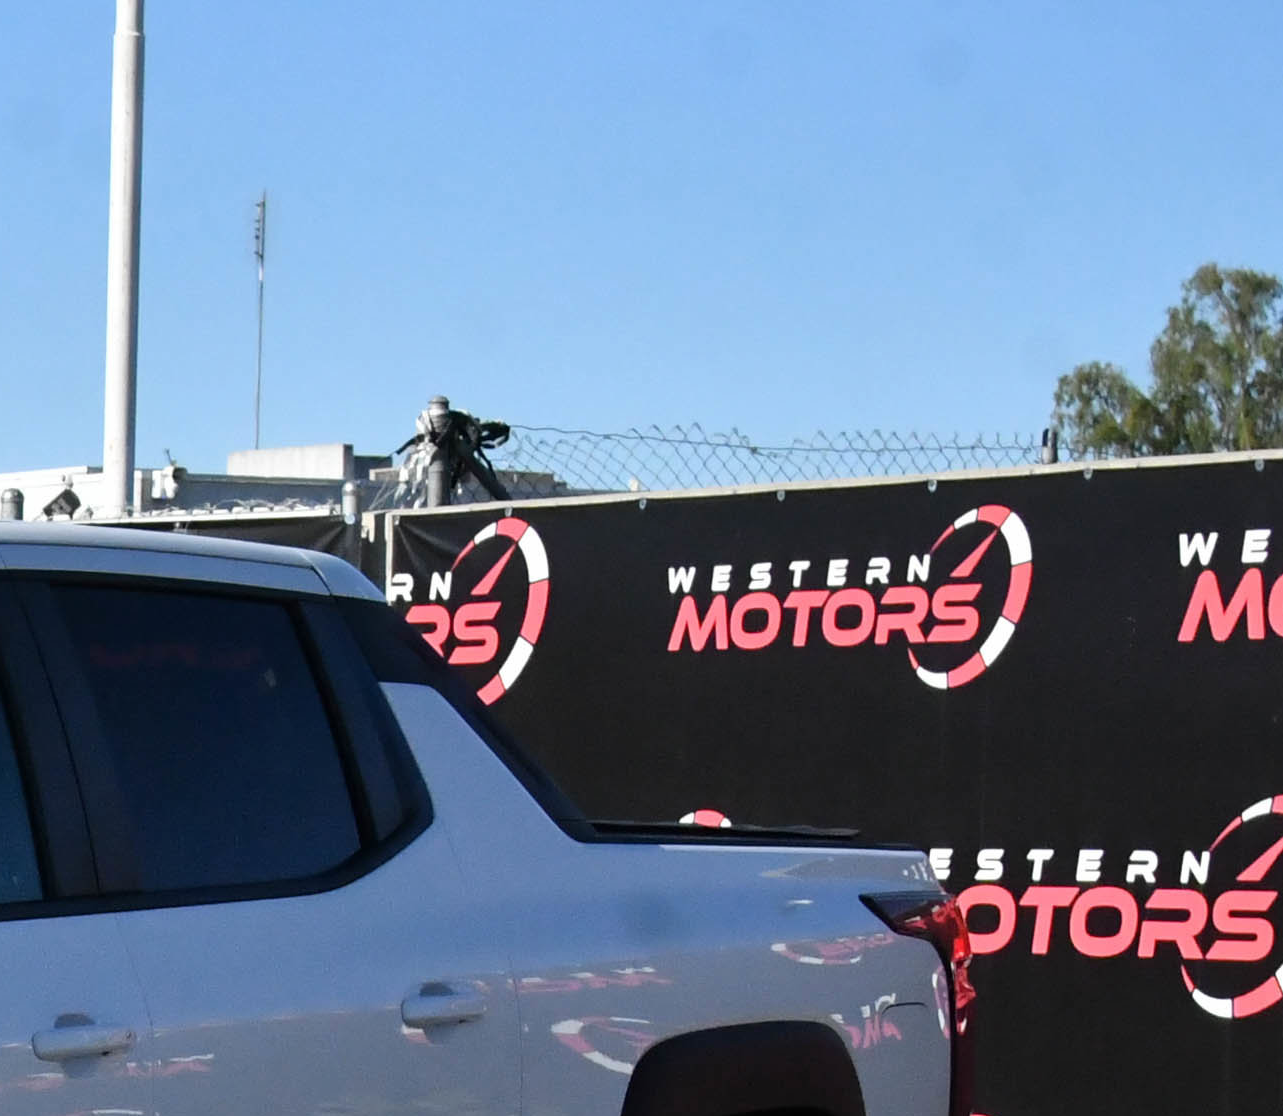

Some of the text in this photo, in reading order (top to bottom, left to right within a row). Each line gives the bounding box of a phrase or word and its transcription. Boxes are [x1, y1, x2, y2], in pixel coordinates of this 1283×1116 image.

[667, 553, 931, 594] WESTERN
[667, 583, 984, 652] MOTORS
[929, 848, 1211, 884] ESTERN
[956, 884, 1279, 962] OTORS
